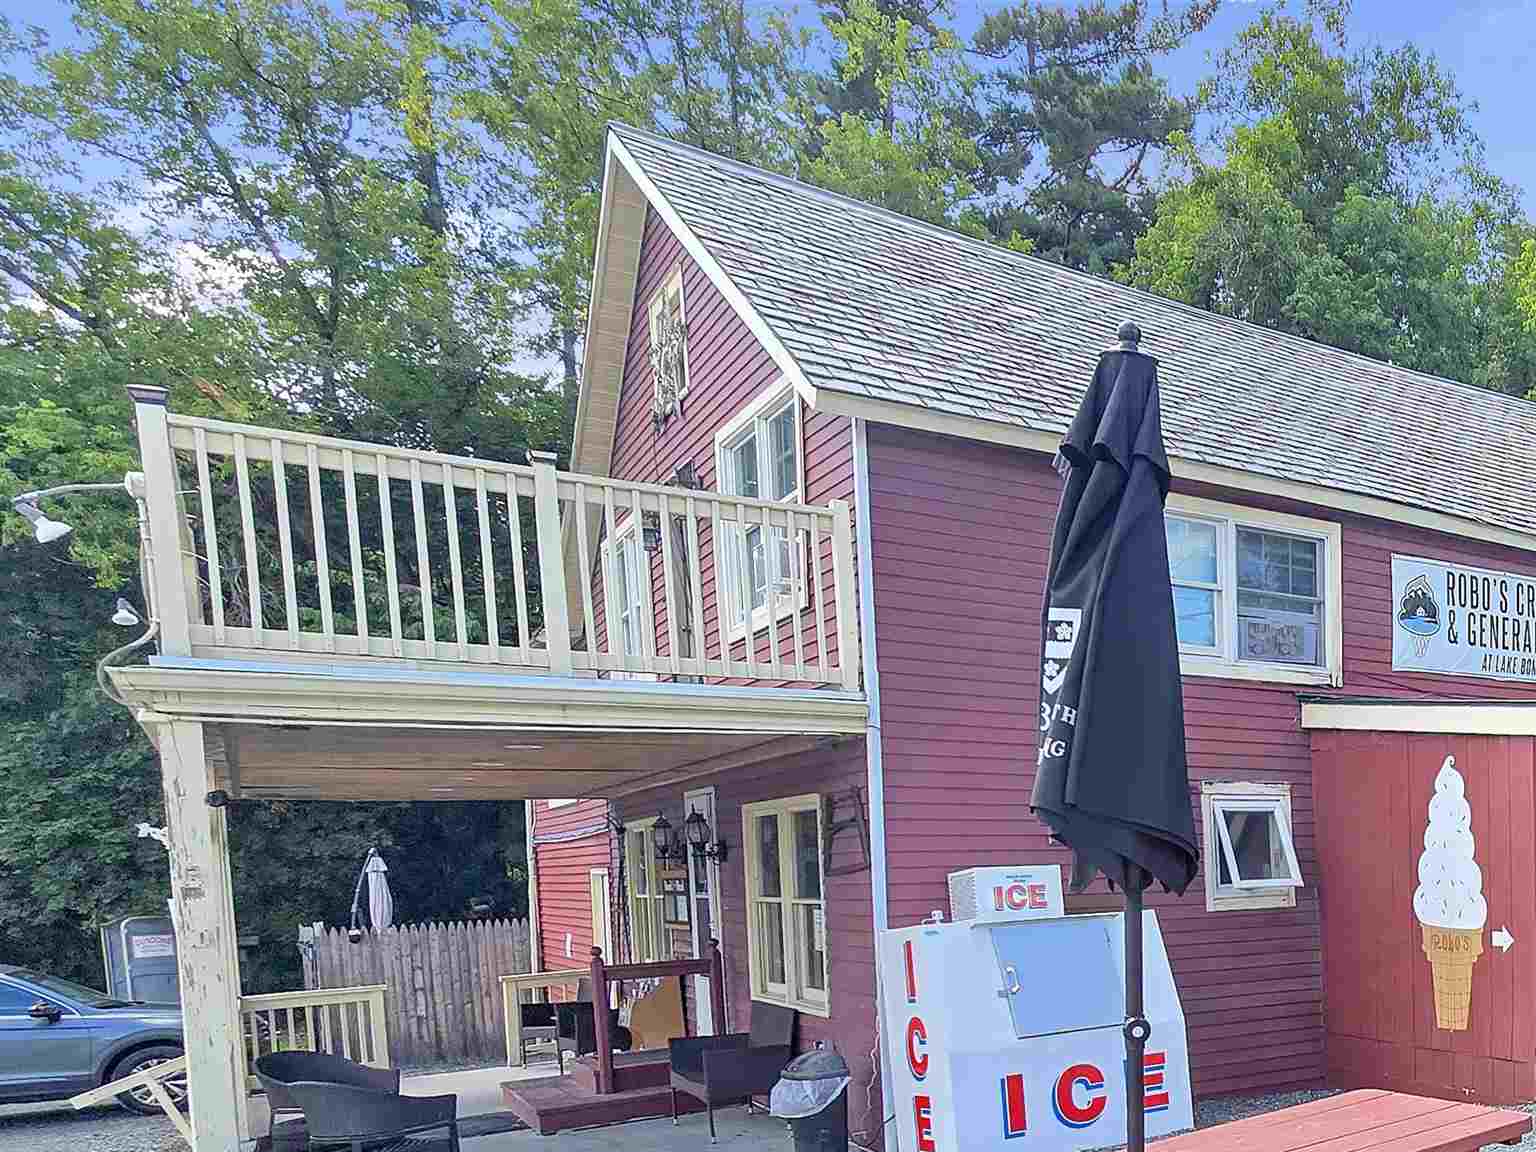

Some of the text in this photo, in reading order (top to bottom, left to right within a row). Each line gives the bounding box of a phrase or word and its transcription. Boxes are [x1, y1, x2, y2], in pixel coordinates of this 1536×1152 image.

[1446, 570, 1508, 613] ROBO'S
[1447, 610, 1459, 645] &
[1481, 654, 1494, 672] AT
[1496, 655, 1519, 674] LAKE
[993, 884, 1049, 911] ICE
[1000, 1051, 1170, 1139] ICE
